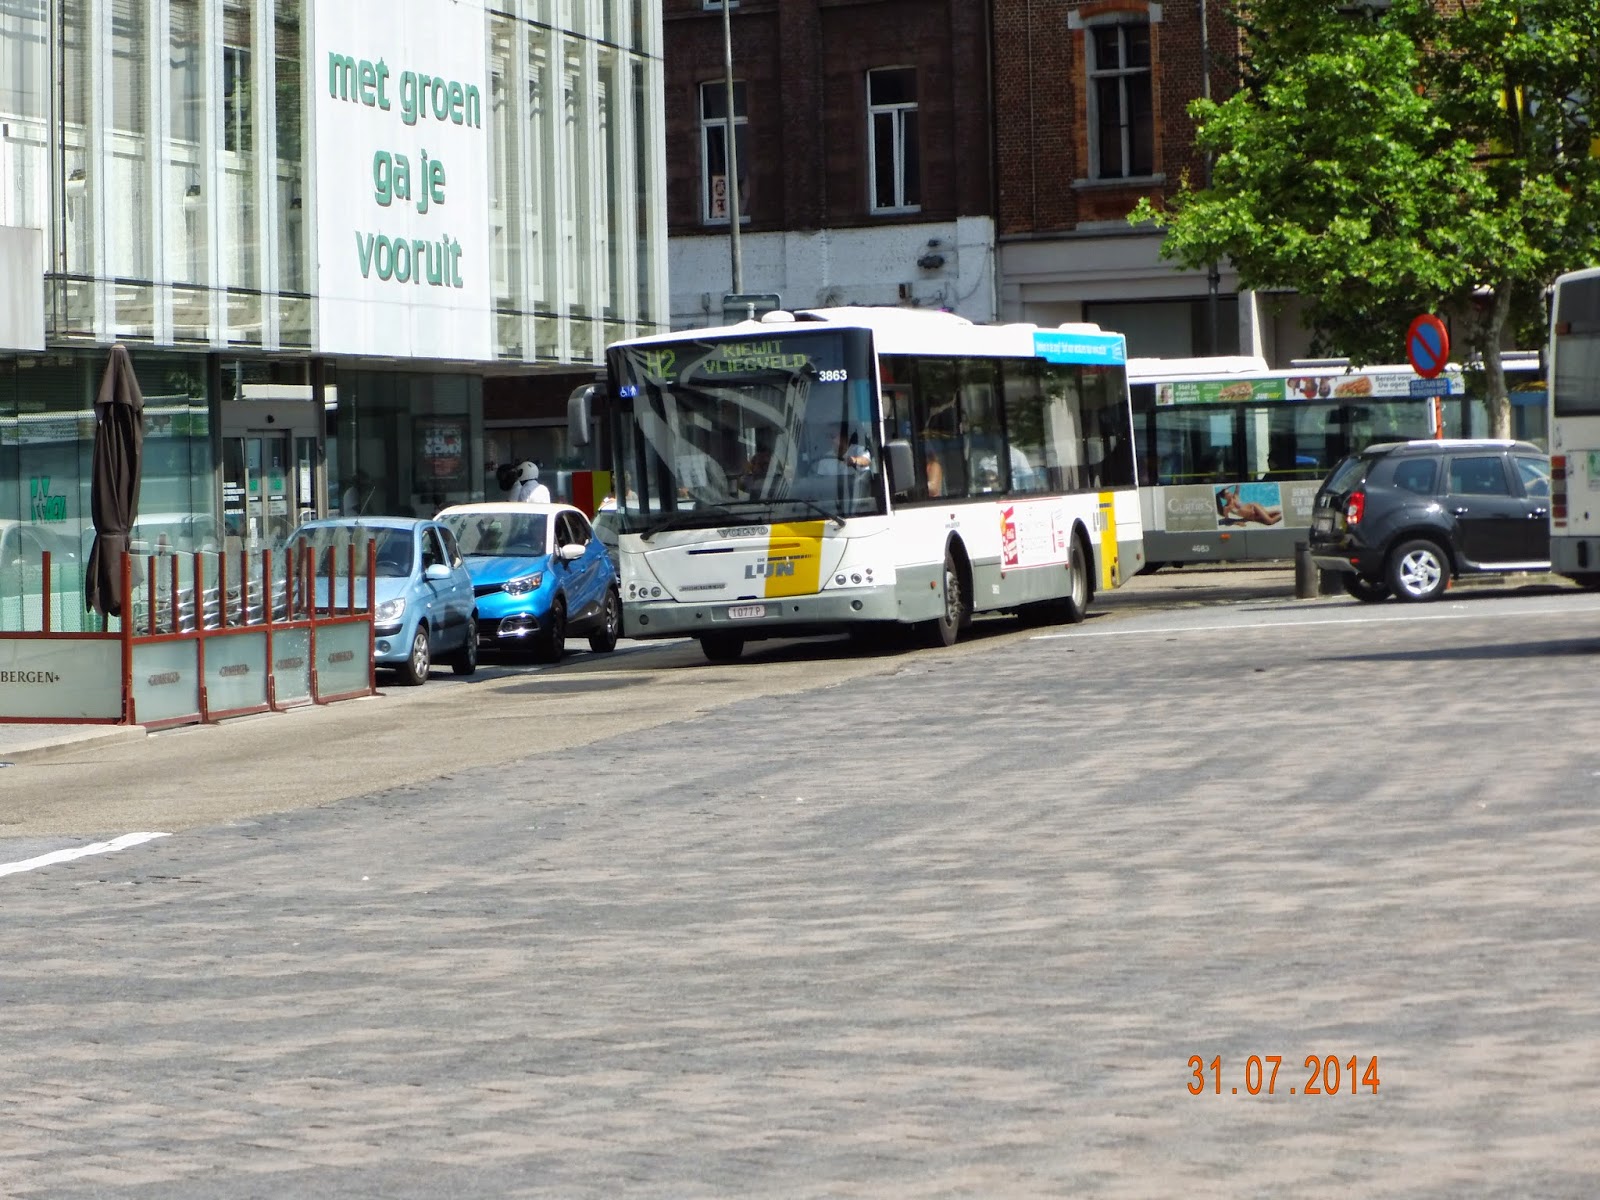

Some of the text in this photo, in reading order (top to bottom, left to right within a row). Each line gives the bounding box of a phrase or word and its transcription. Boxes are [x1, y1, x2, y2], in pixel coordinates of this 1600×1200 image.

[328, 51, 481, 129] met groen
[373, 148, 446, 214] ga je
[355, 230, 464, 288] vooruit
[721, 340, 784, 357] KIEWIT
[645, 349, 677, 378] H2
[703, 353, 807, 373] VLIEGVELD
[818, 369, 848, 382] 3863
[717, 525, 769, 538] VOLVO
[744, 561, 795, 580] LIJN
